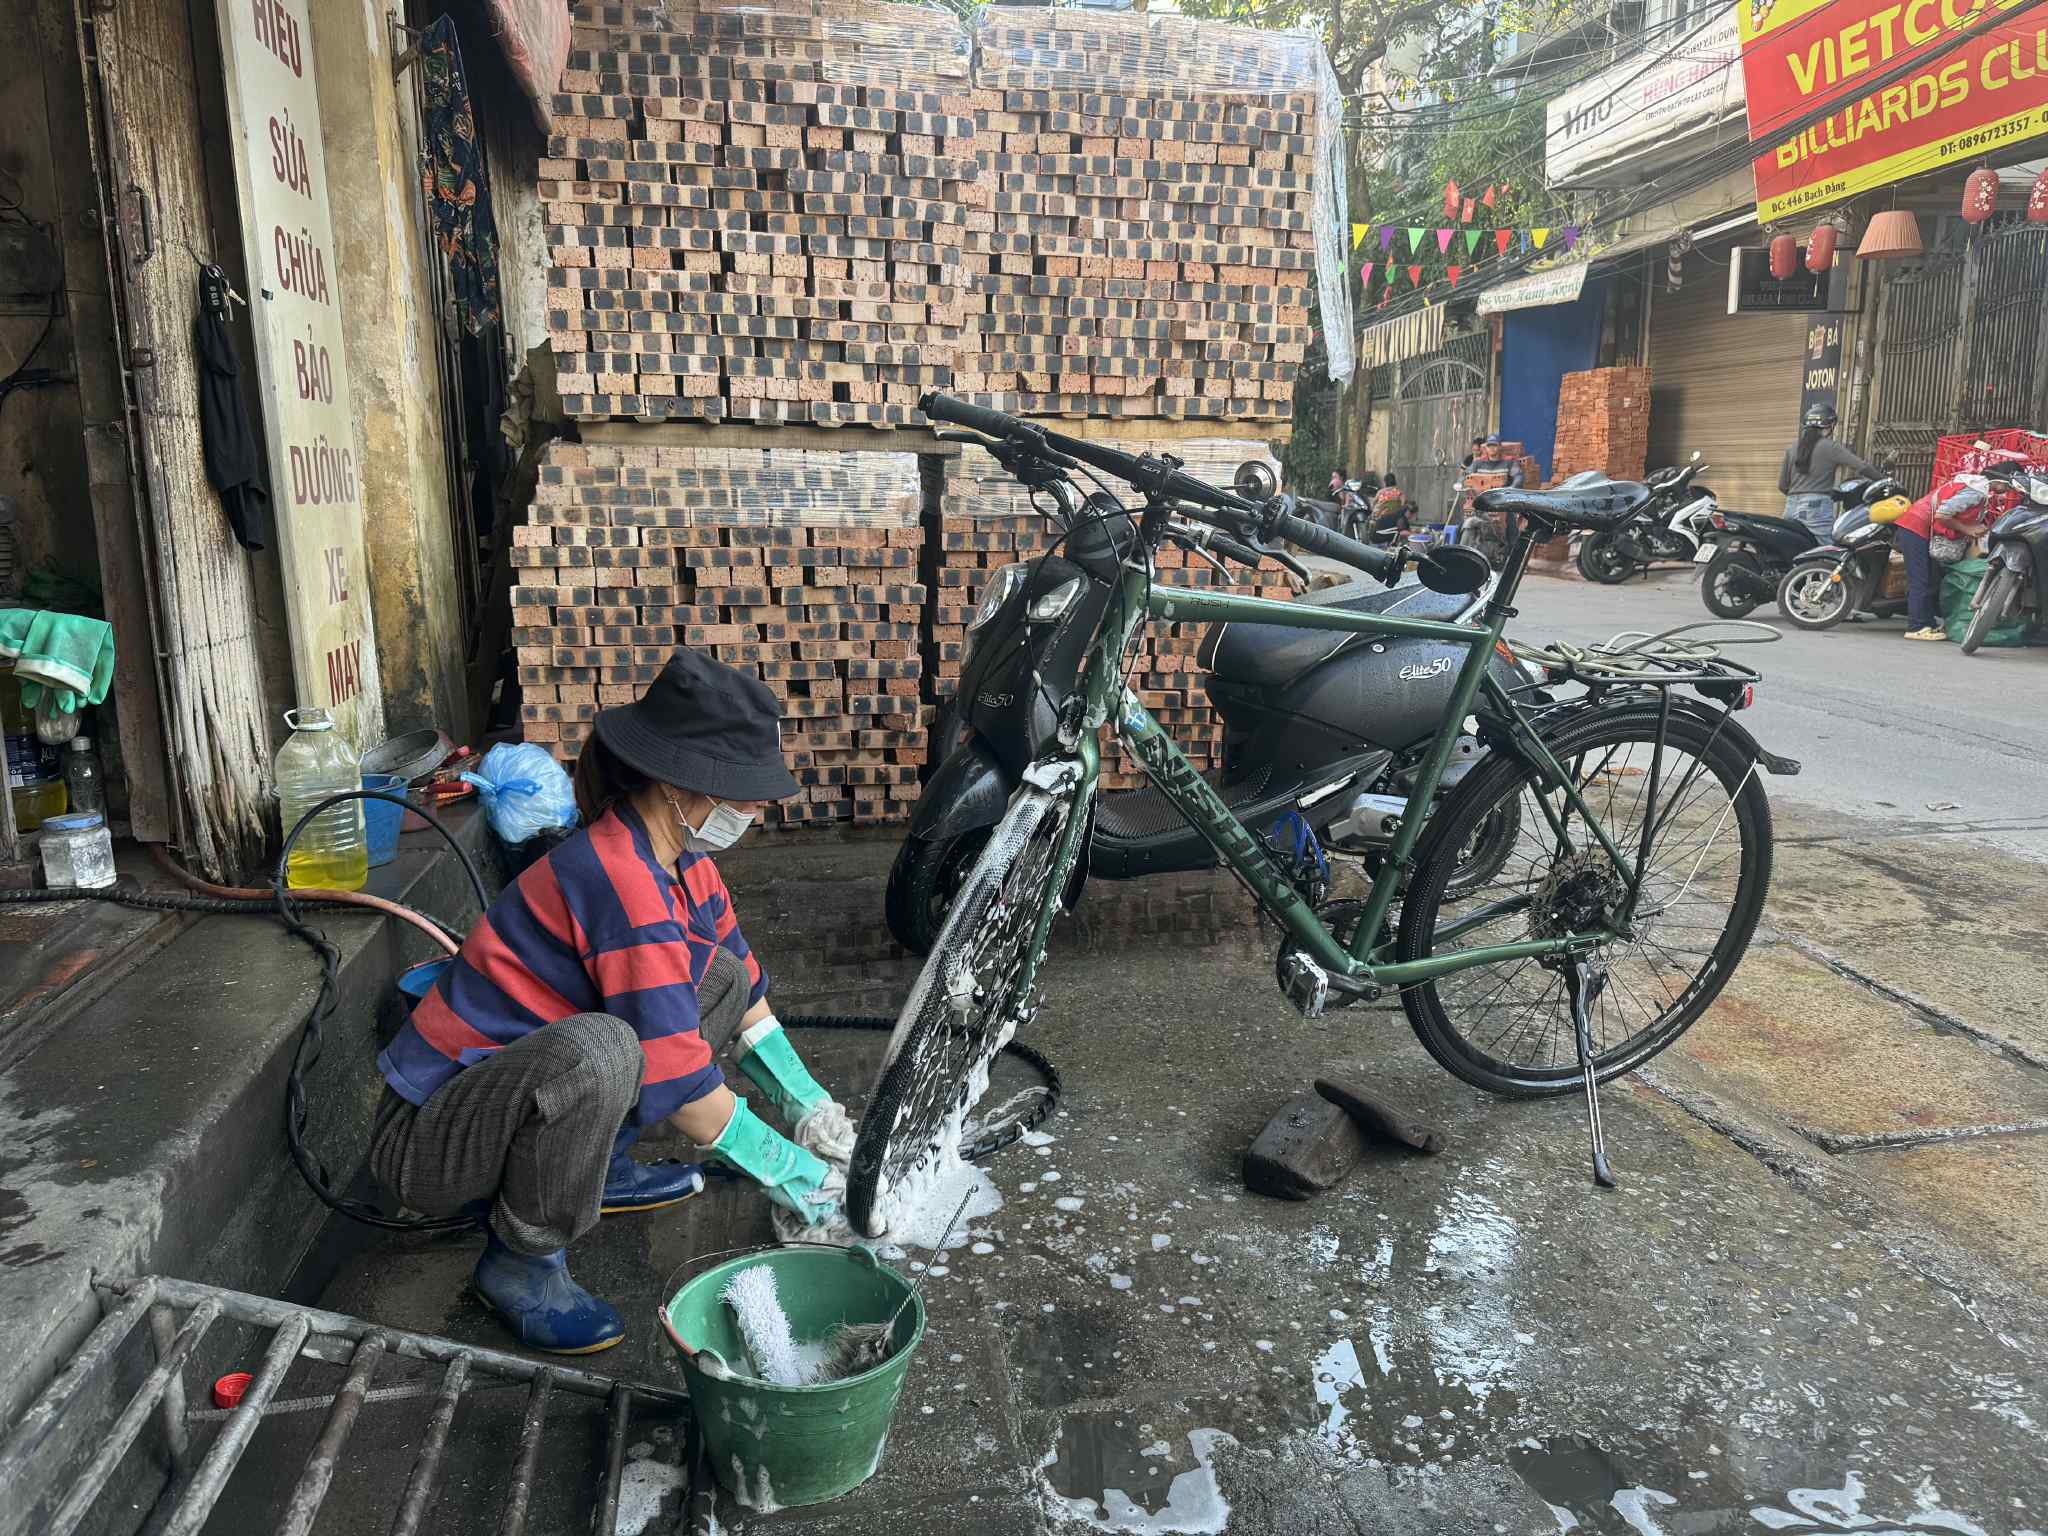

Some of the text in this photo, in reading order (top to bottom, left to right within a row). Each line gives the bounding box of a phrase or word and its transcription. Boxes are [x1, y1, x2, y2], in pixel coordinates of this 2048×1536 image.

[1776, 59, 1970, 169] BILLIARDS
[1959, 116, 2030, 150] 0896723357
[269, 107, 312, 201] SỬA
[274, 225, 330, 306] CHỮA
[293, 323, 332, 404] BẢO
[1806, 368, 1835, 389] JOTON
[289, 434, 355, 505] DƯỠNG
[324, 547, 348, 605] XE
[327, 630, 362, 707] MÁY
